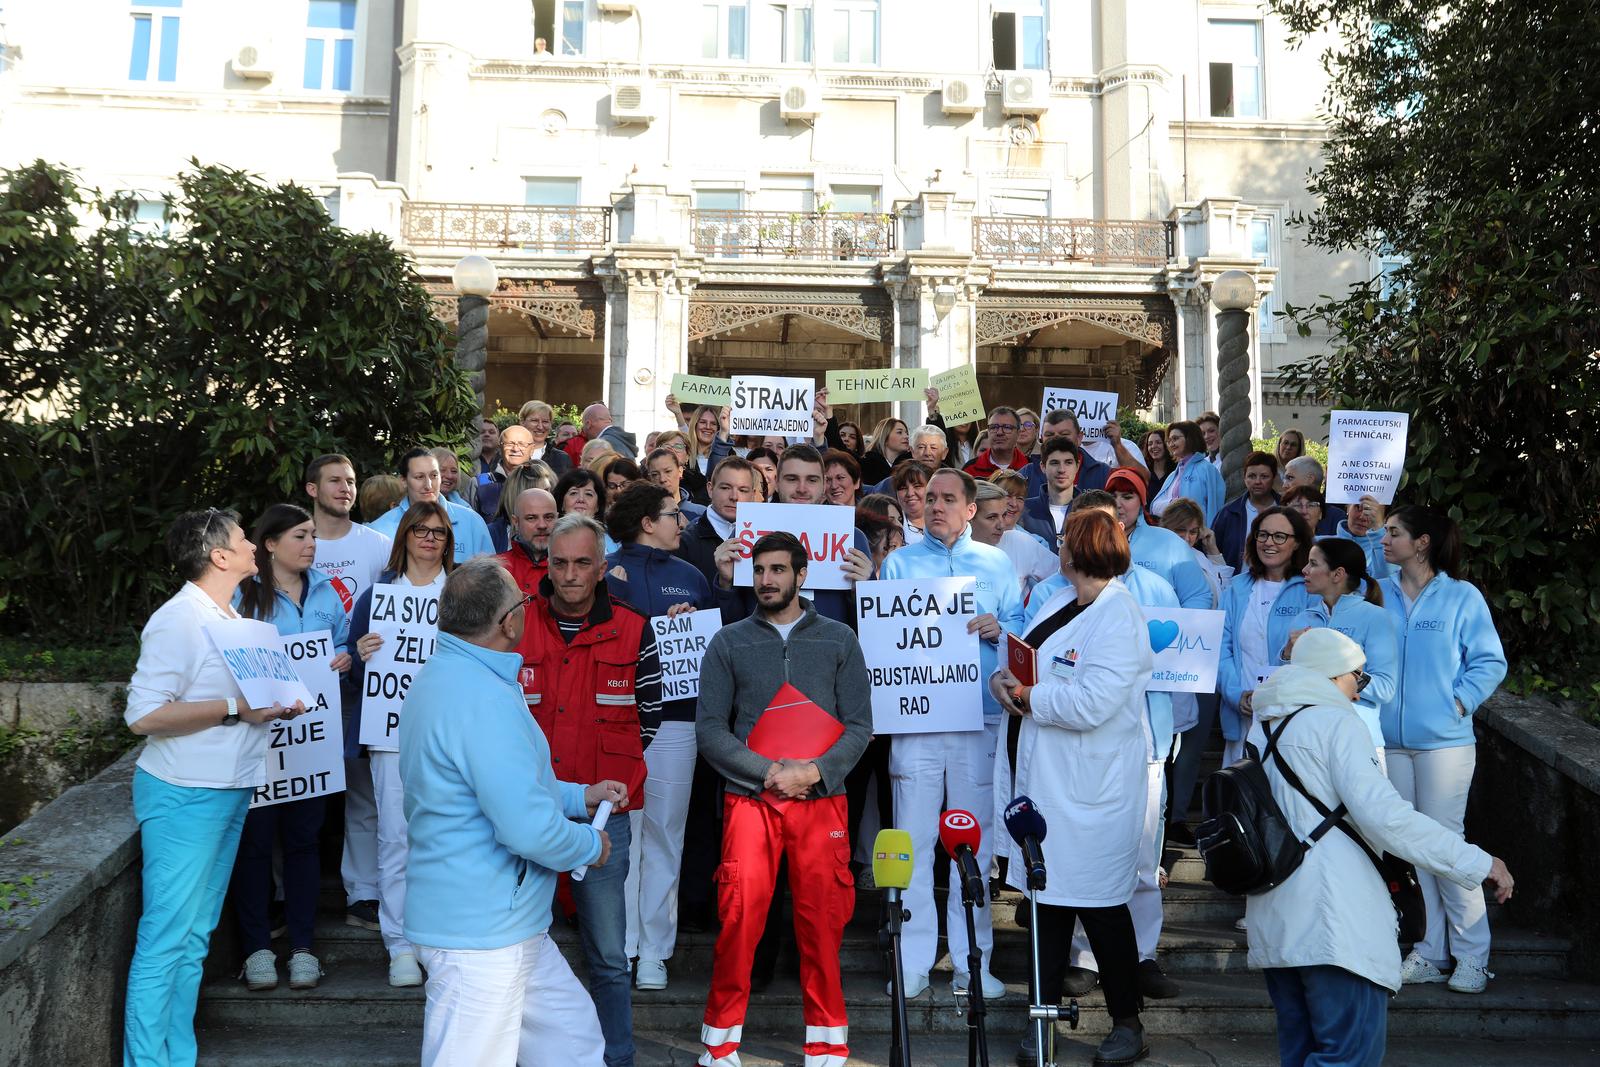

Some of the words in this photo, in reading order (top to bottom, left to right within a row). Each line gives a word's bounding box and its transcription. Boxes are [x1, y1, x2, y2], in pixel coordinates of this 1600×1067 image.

[681, 381, 730, 396] FARMA
[836, 374, 915, 391] TEHNIČARI
[735, 380, 808, 411] ŠTRAJK
[945, 411, 967, 421] PLAĆA
[1337, 418, 1402, 428] FARMACEUTSKI
[732, 417, 772, 431] SINDIKATA
[773, 419, 809, 433] ZAJEDNO
[1343, 430, 1394, 441] TEHNIČARI,
[1362, 460, 1391, 469] OSTALI
[1337, 472, 1392, 481] ZDRAVSTVENI
[1343, 484, 1385, 493] RADNICI!!!
[326, 568, 344, 576] KRV
[372, 593, 396, 622] ZA
[401, 596, 439, 626] SVO
[860, 589, 941, 618] PLAĆA
[947, 592, 975, 615] JE
[656, 616, 693, 636] SAM
[658, 635, 707, 657] ISTAR
[896, 626, 943, 650] JAD
[1165, 670, 1199, 683] Zajedno
[899, 696, 930, 716] RAD
[270, 720, 325, 749] ŽIJE
[278, 751, 285, 771] I
[249, 771, 331, 804] REDIT
